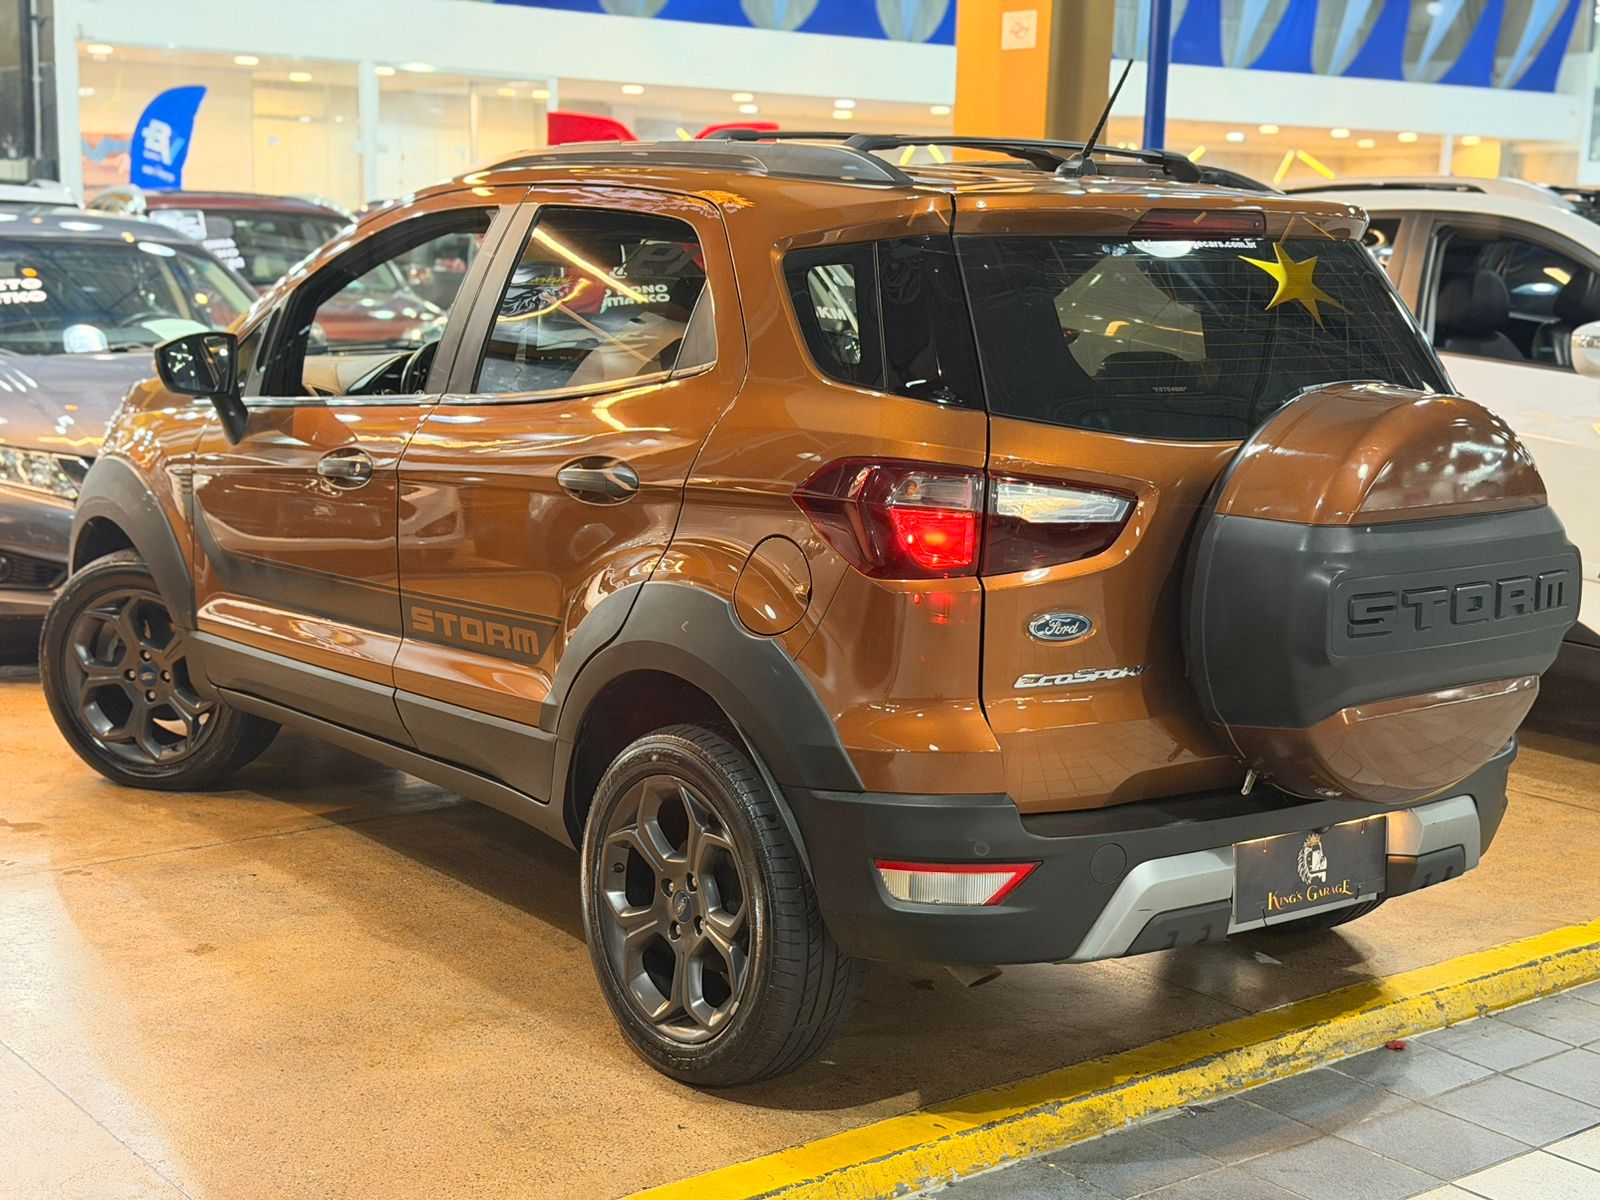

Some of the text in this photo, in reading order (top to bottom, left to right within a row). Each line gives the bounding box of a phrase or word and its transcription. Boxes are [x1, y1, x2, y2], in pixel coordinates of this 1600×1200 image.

[1044, 618, 1080, 635] Ford
[1347, 568, 1570, 639] STORM
[410, 606, 540, 656] STORM
